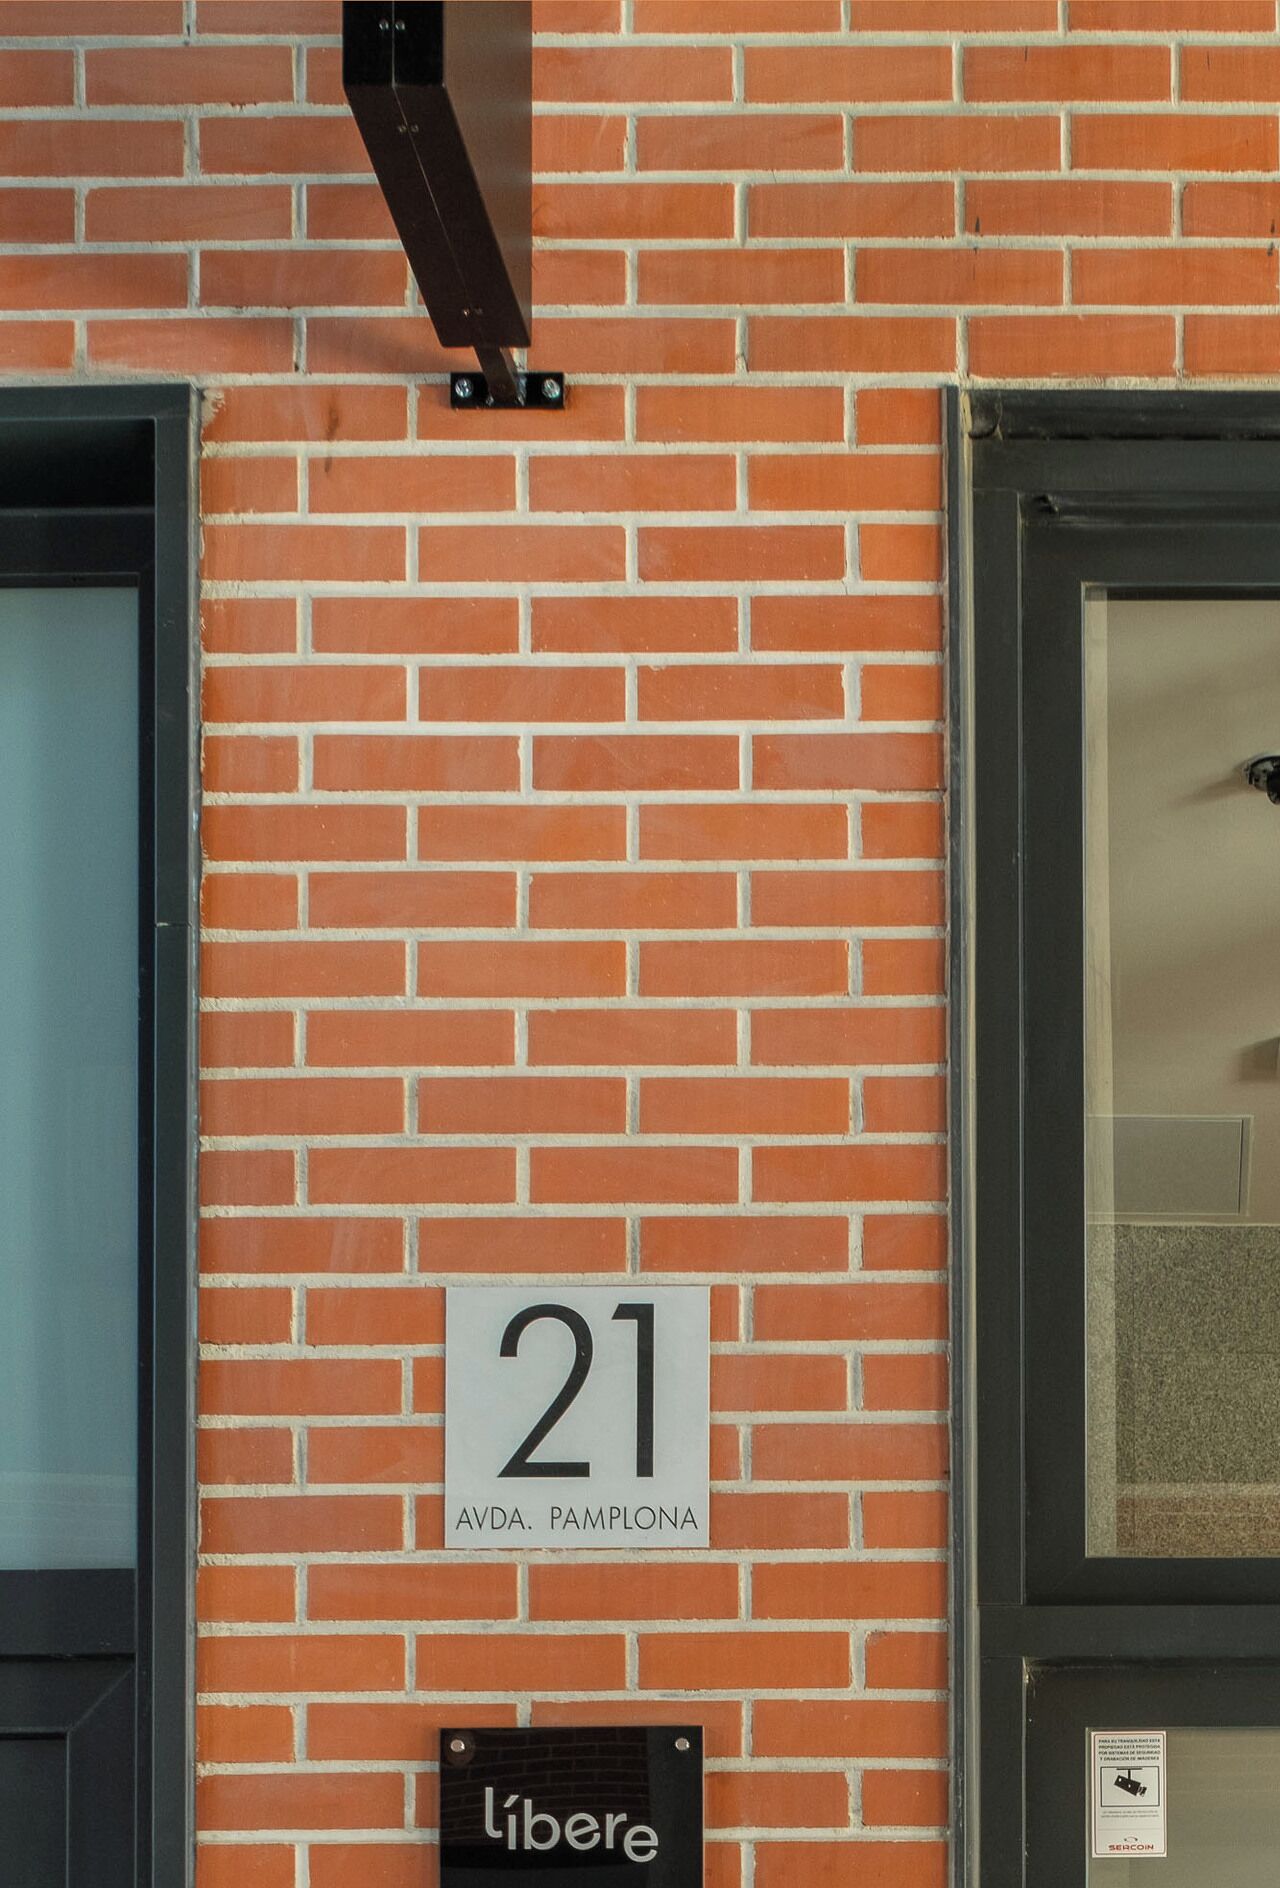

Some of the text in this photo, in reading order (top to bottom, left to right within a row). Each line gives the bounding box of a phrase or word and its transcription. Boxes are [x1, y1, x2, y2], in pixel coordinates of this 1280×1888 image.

[497, 1303, 655, 1478] 21
[455, 1506, 699, 1531] AVDA. PAMPLONA
[485, 1787, 659, 1863] líbere
